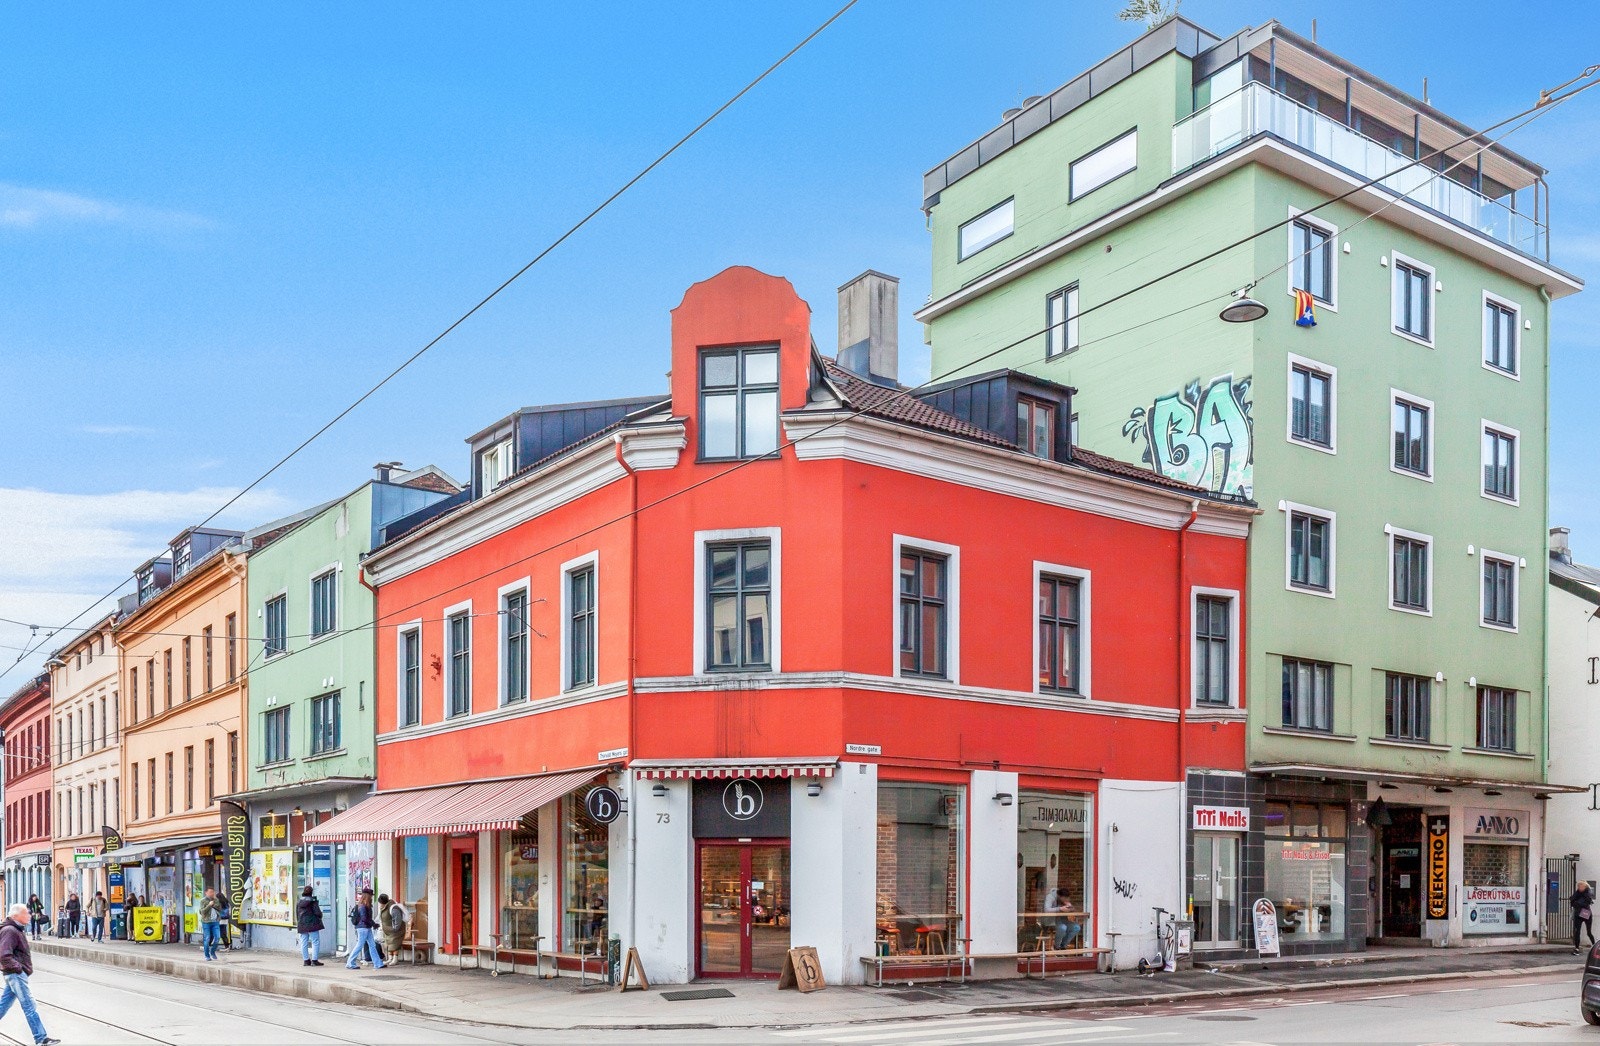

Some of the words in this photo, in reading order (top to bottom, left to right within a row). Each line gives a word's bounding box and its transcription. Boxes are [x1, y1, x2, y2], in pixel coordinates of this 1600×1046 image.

[656, 813, 671, 823] 73
[1219, 810, 1247, 827] Nails
[1433, 839, 1444, 908] ELEKTRO
[1467, 890, 1520, 900] LAGERUTSALG
